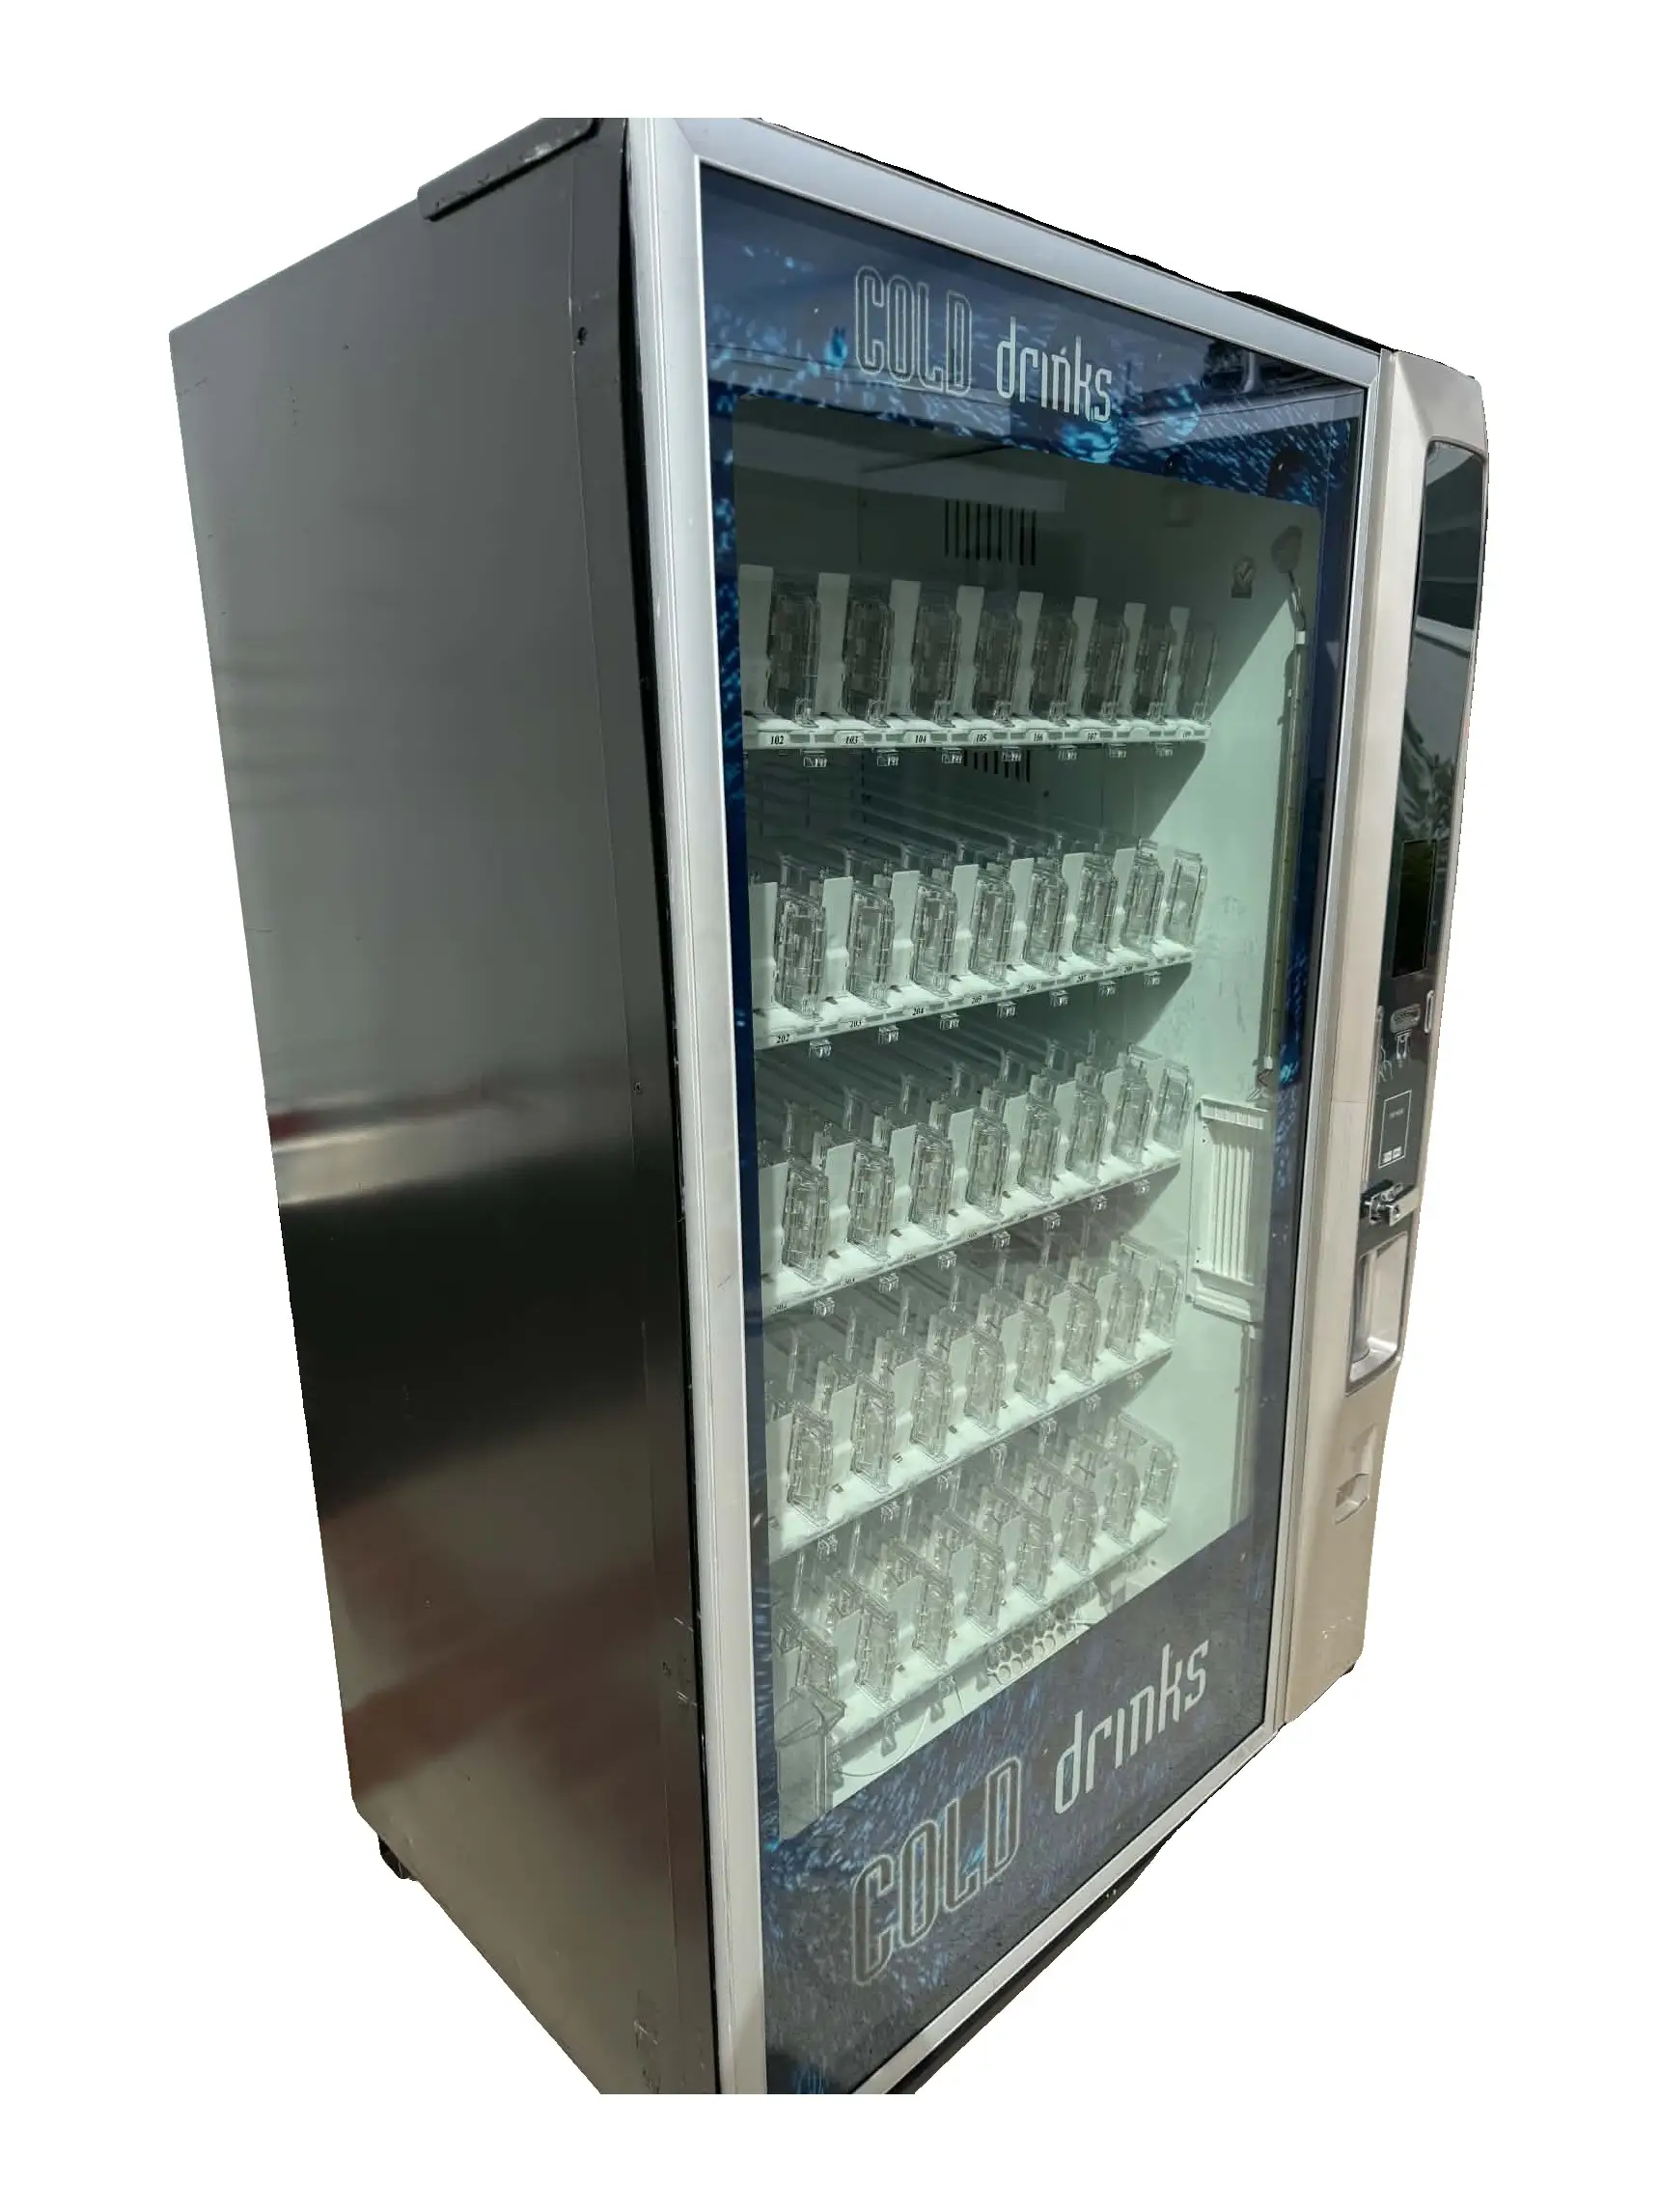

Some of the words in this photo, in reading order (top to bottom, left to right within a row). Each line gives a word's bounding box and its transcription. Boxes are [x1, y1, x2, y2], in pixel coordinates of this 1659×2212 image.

[855, 265, 972, 396] COLD
[996, 316, 1112, 423] drinks
[770, 735, 784, 745] 102
[845, 735, 859, 744] 103
[914, 734, 926, 744] 104
[976, 733, 987, 743] 105
[1087, 732, 1097, 741] 107
[776, 1034, 790, 1043] 202
[850, 1756, 1022, 1987] COLD
[1054, 1640, 1210, 1814] drinks
